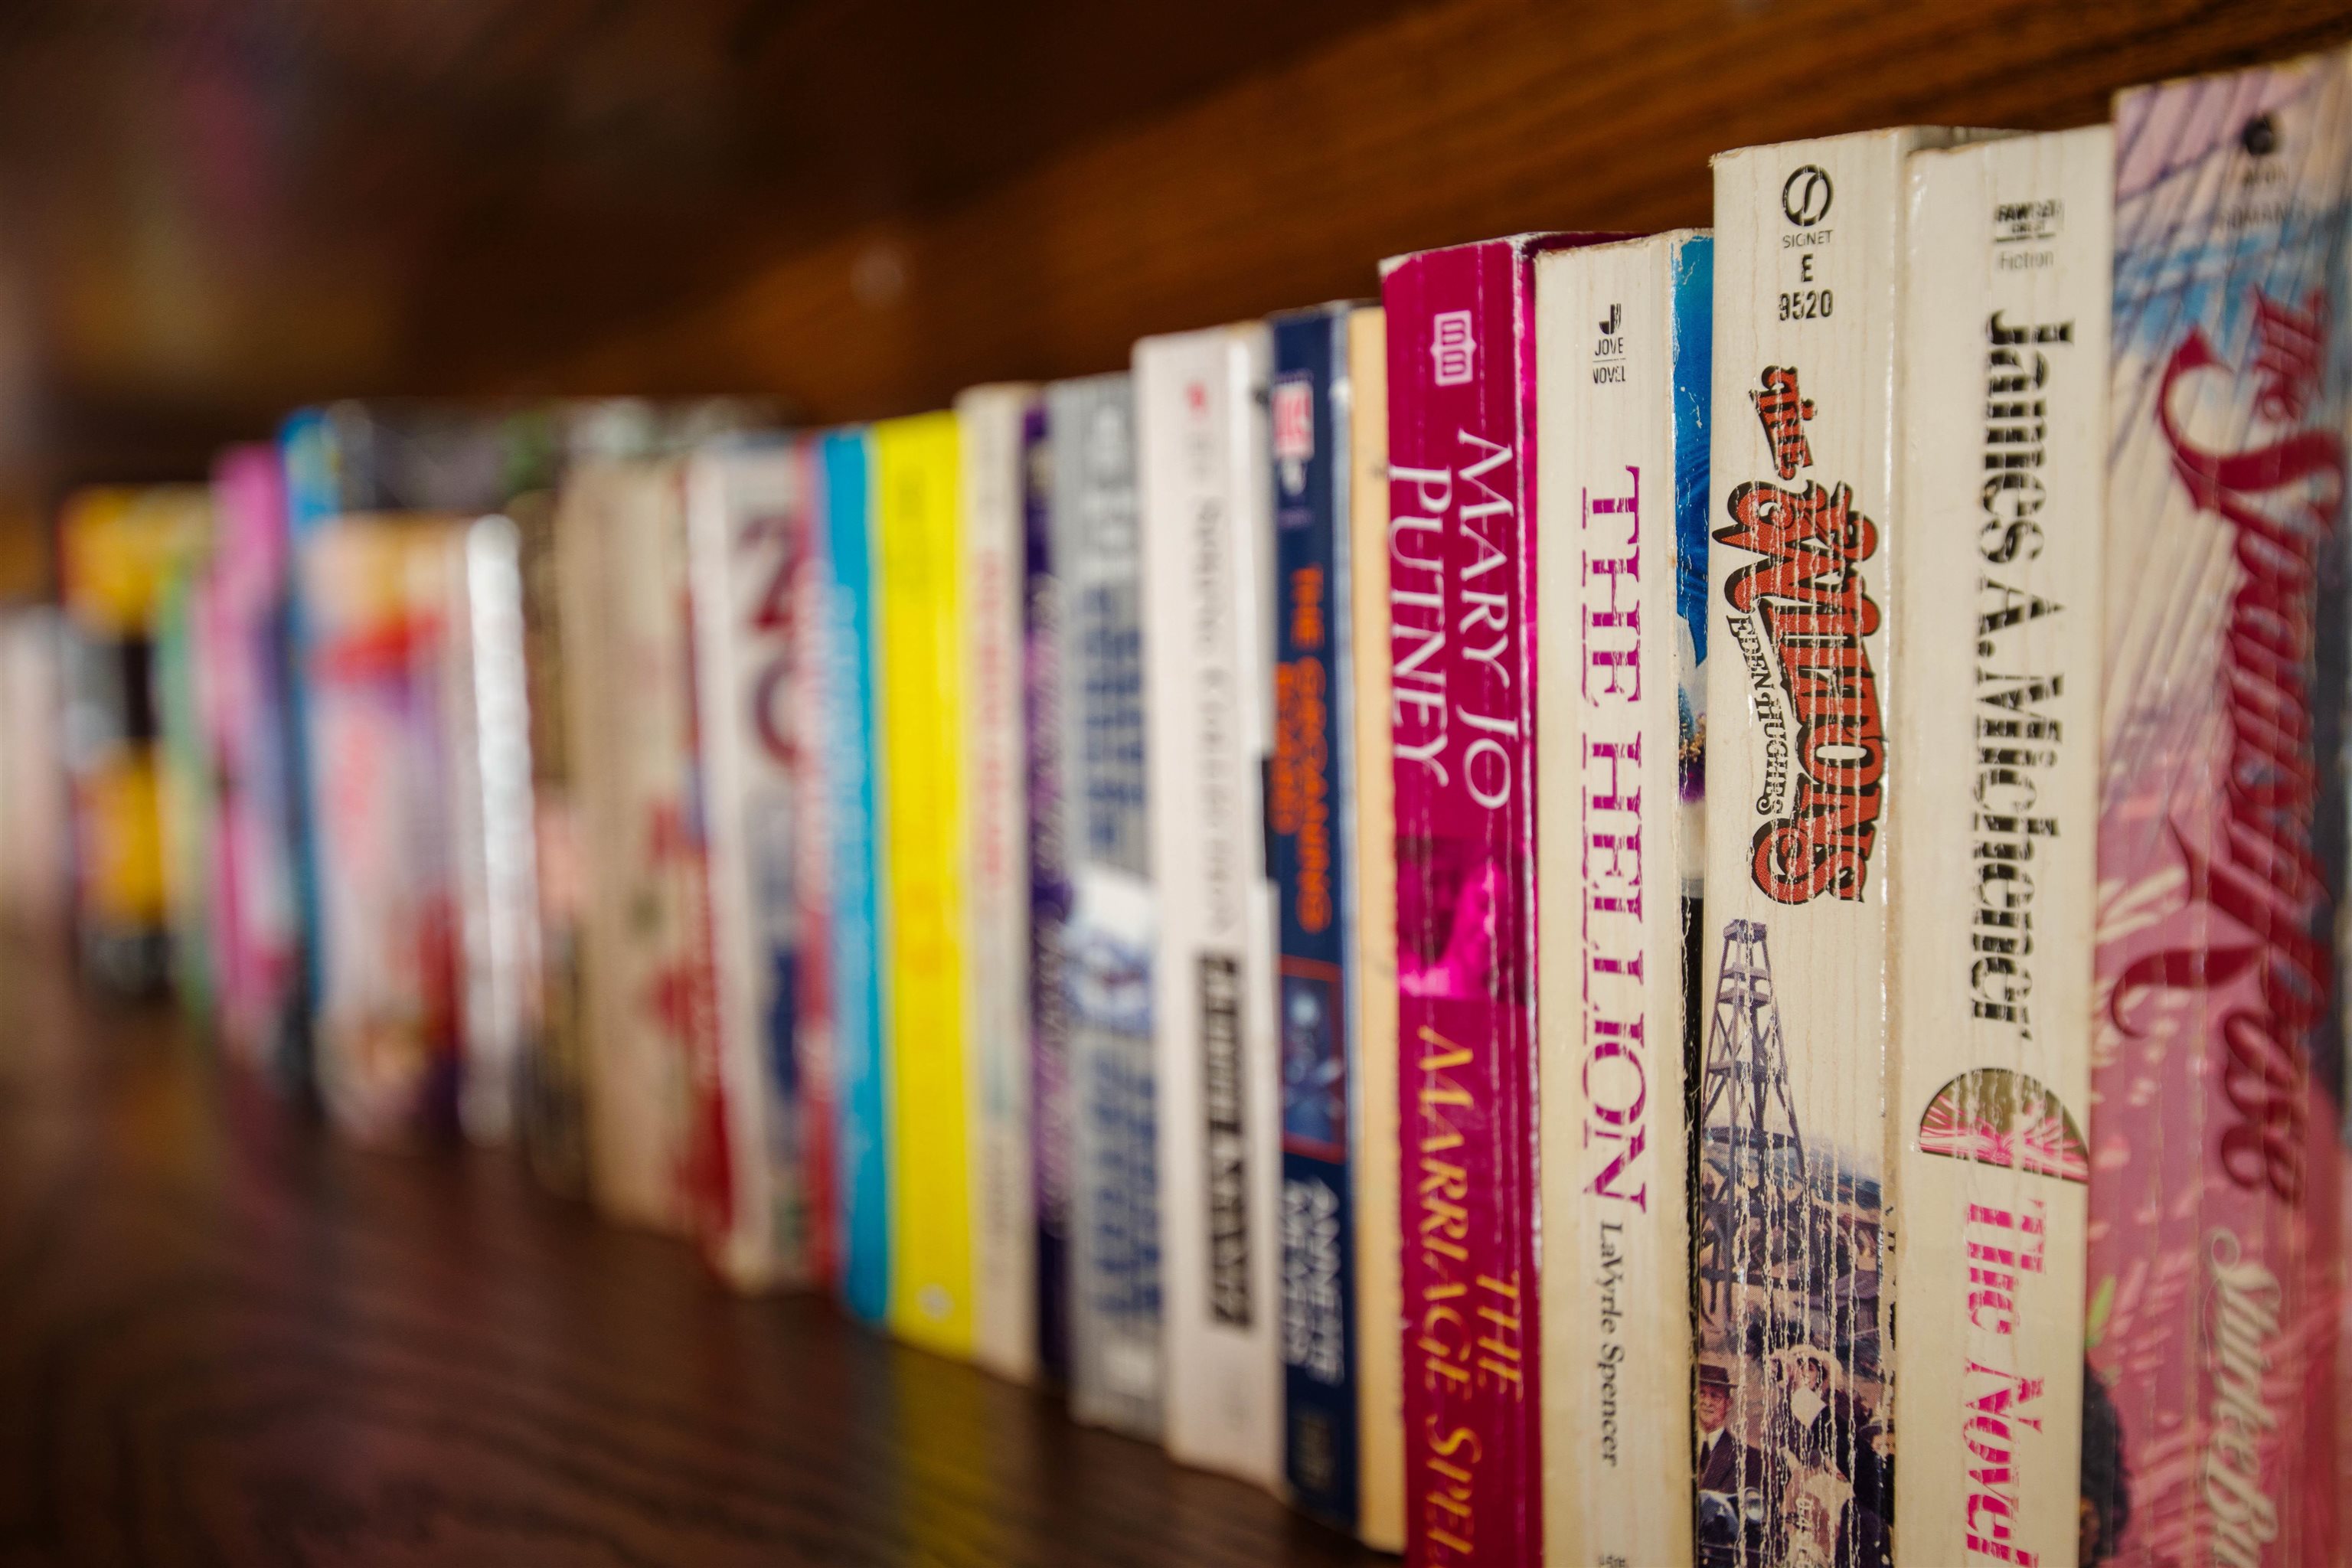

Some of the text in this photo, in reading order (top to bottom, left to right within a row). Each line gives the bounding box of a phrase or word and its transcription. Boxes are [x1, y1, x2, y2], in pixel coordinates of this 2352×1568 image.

[1595, 338, 1624, 355] JOVE
[1782, 230, 1833, 248] SIGNET
[1802, 254, 1814, 283] E
[2000, 250, 2055, 270] Fiction
[1592, 364, 1626, 384] NOVEL
[1388, 465, 1452, 787] PUTNEY
[1456, 429, 1518, 809] MARY JO
[1712, 364, 1888, 905] THE WILTONS
[1726, 615, 1788, 815] EDEN HUGHES
[1969, 309, 2076, 1040] James A. Michener
[1582, 465, 1648, 1214] THE HELLION
[1418, 1026, 1482, 1568] MARRIAGE SPEL
[1476, 1272, 1523, 1402] THE
[1598, 1220, 1625, 1466] LaVyrle Spencer
[1962, 1198, 2047, 1568] The Novel
